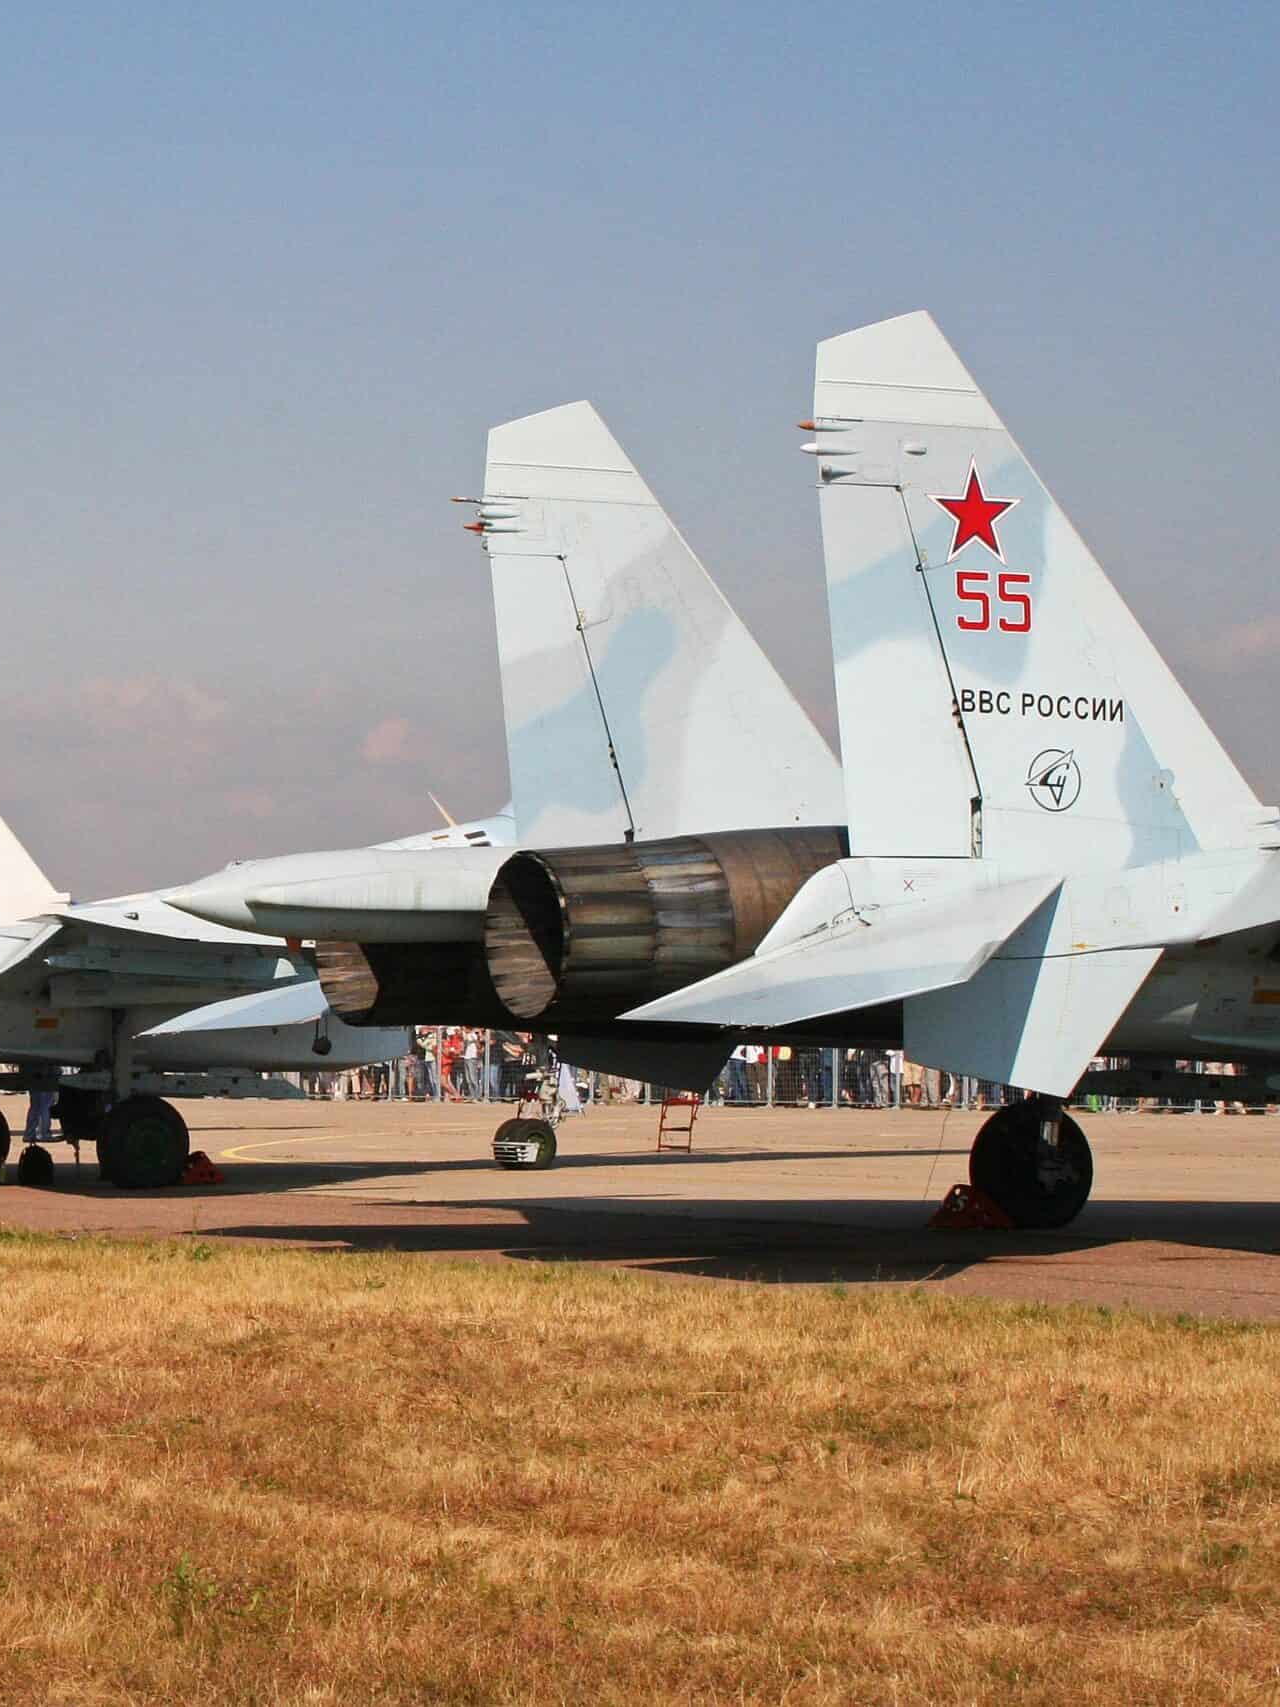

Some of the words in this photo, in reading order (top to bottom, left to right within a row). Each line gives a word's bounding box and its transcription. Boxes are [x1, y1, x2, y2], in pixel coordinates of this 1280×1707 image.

[955, 571, 1032, 633] 55
[961, 689, 1011, 715] ВВС
[1021, 692, 1125, 722] РОССИИ
